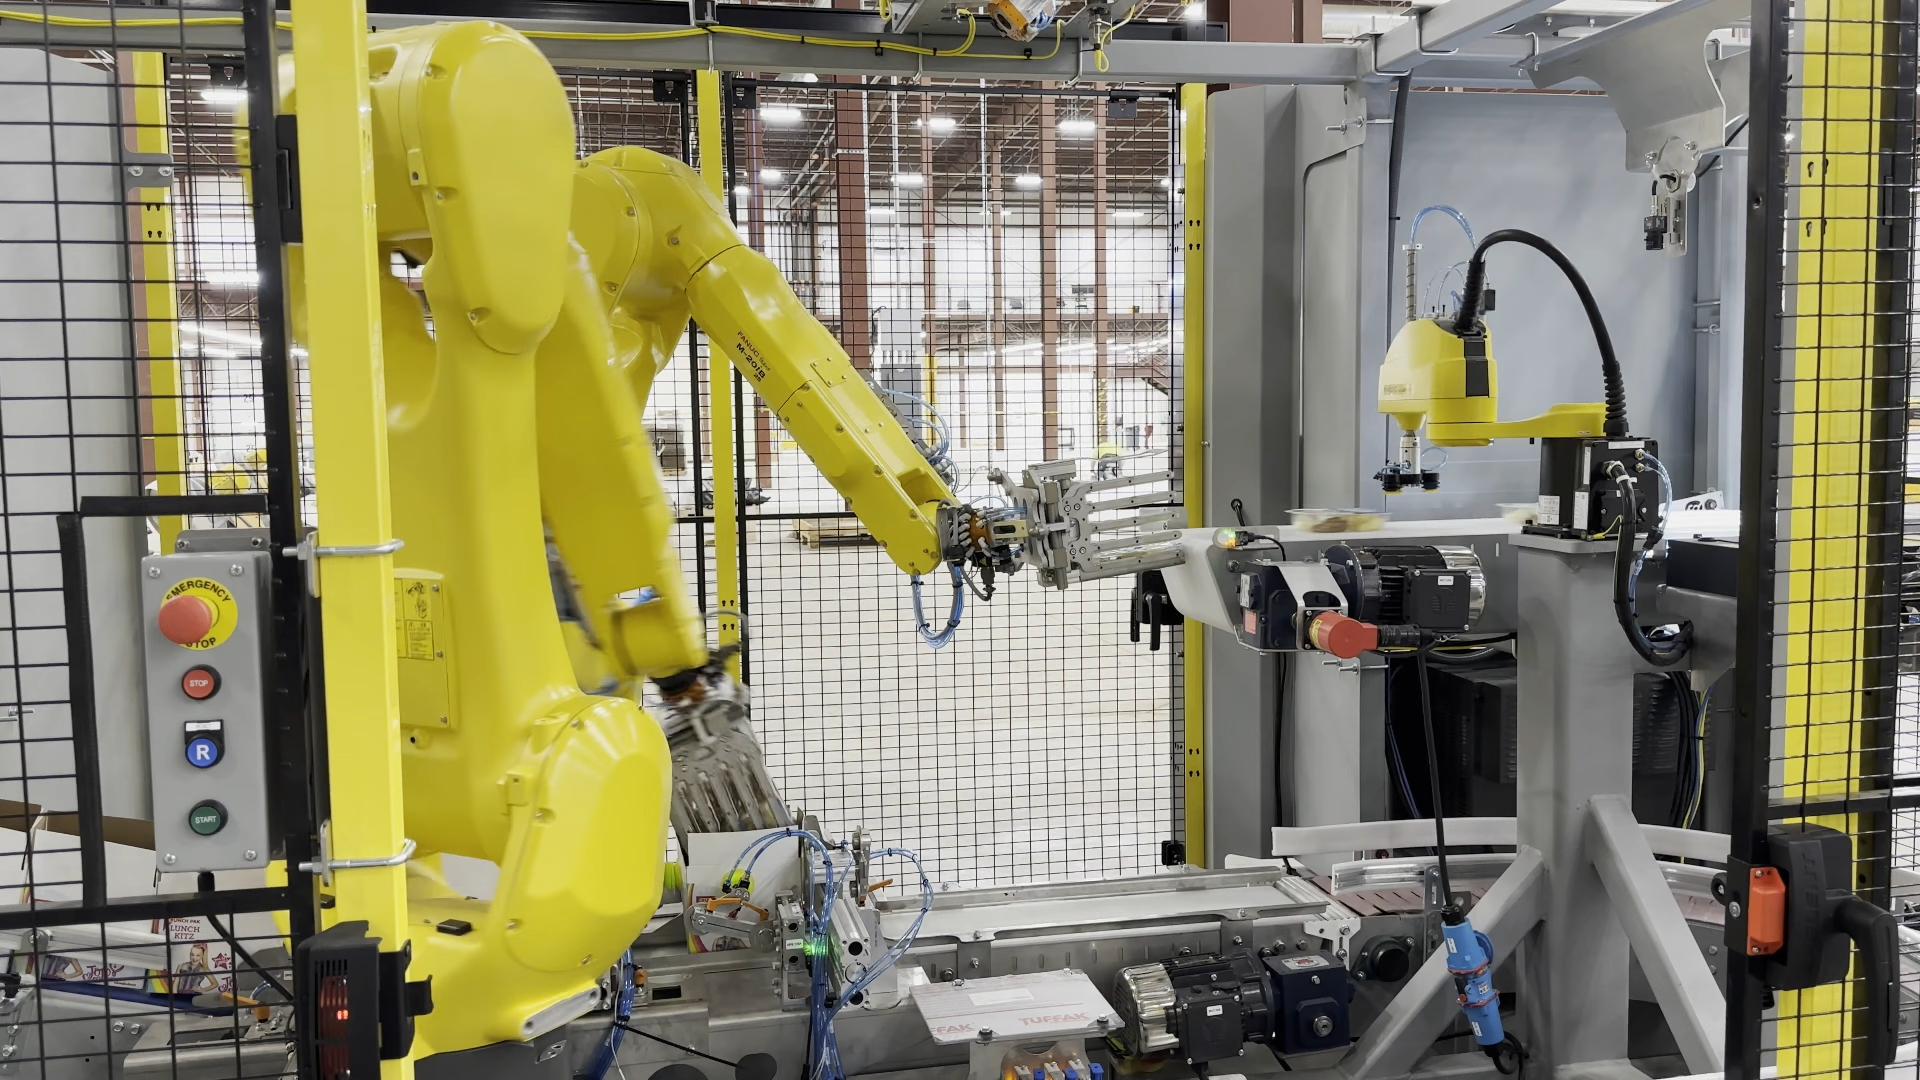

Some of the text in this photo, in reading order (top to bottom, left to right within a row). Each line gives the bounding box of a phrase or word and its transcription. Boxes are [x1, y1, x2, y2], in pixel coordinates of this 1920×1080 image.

[737, 331, 760, 358] FANUC
[166, 580, 231, 601] EMERGENCY
[196, 744, 210, 760] R
[195, 815, 217, 824] START
[170, 925, 200, 933] LUNCH
[174, 932, 195, 940] KITZ
[1018, 1012, 1088, 1026] TUFFAK
